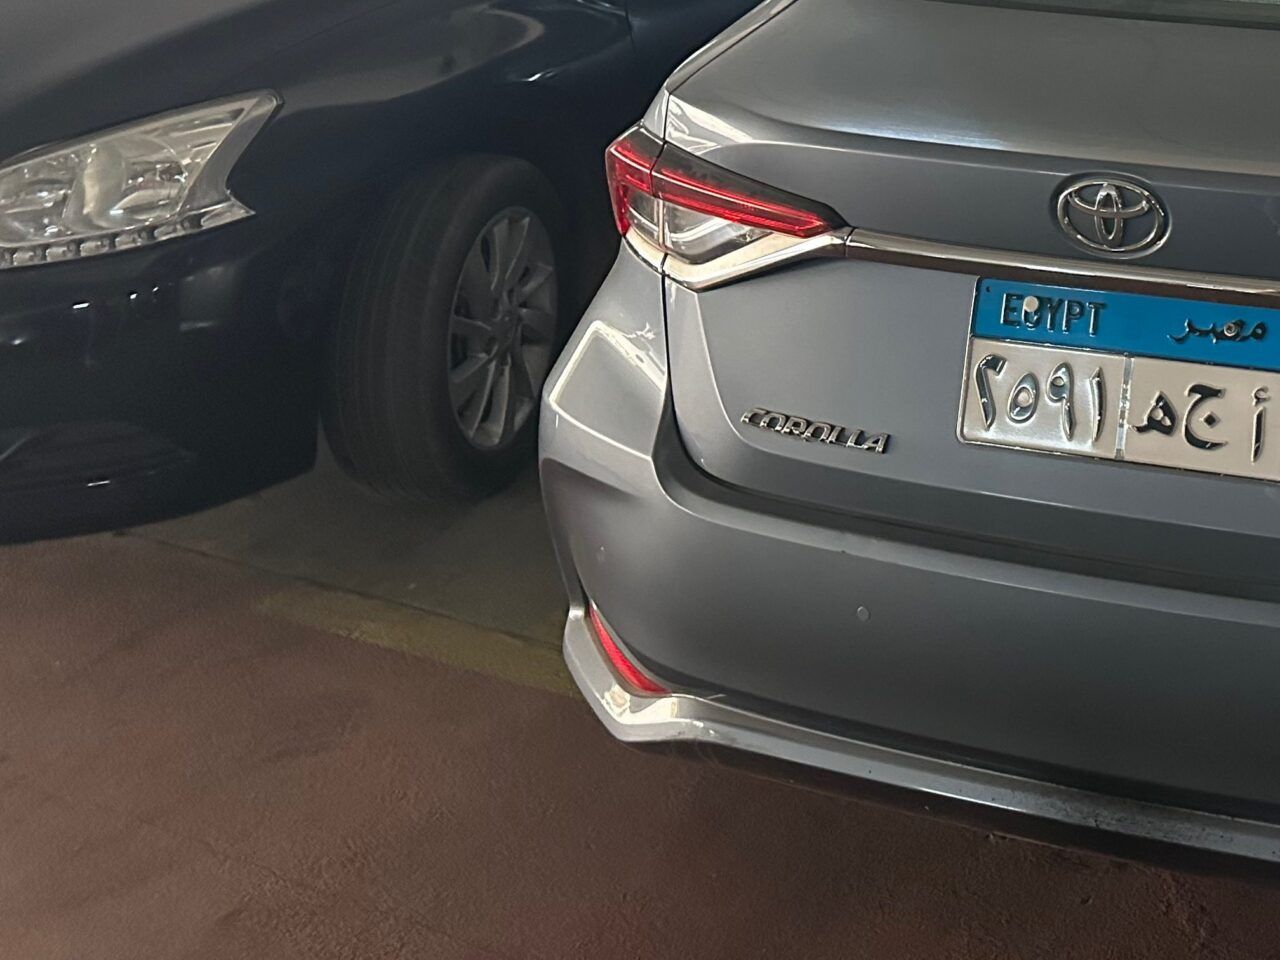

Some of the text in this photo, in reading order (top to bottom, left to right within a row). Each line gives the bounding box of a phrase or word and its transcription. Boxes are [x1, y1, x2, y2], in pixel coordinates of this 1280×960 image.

[1000, 292, 1105, 337] EGYPT
[1166, 318, 1268, 345] مصر
[740, 407, 890, 454] COROLLA
